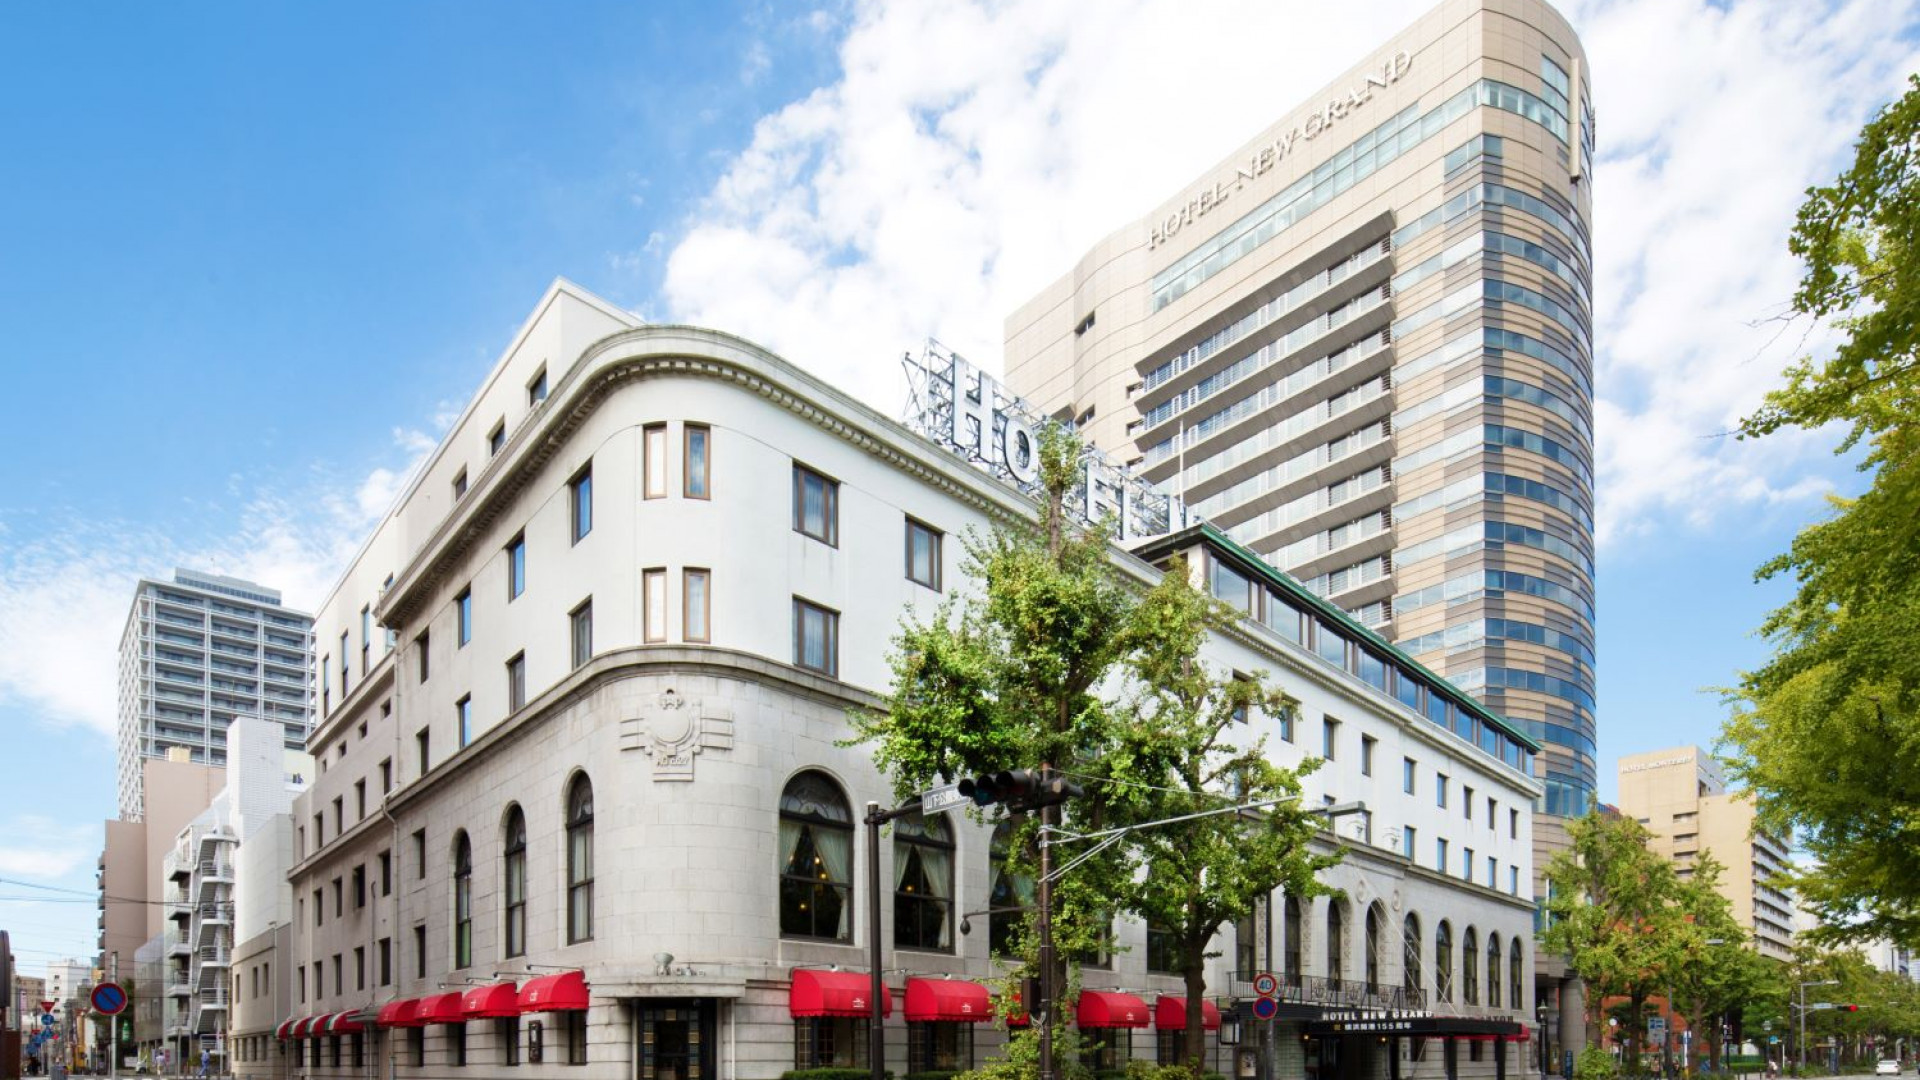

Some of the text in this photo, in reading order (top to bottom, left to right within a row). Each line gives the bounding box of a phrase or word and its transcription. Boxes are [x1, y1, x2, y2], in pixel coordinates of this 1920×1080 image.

[1148, 50, 1413, 250] HOTEL NEW GRAND
[952, 352, 1150, 541] HOEL
[1259, 979, 1272, 990] 40
[1322, 1009, 1433, 1021] HOTEL NEW GRAND
